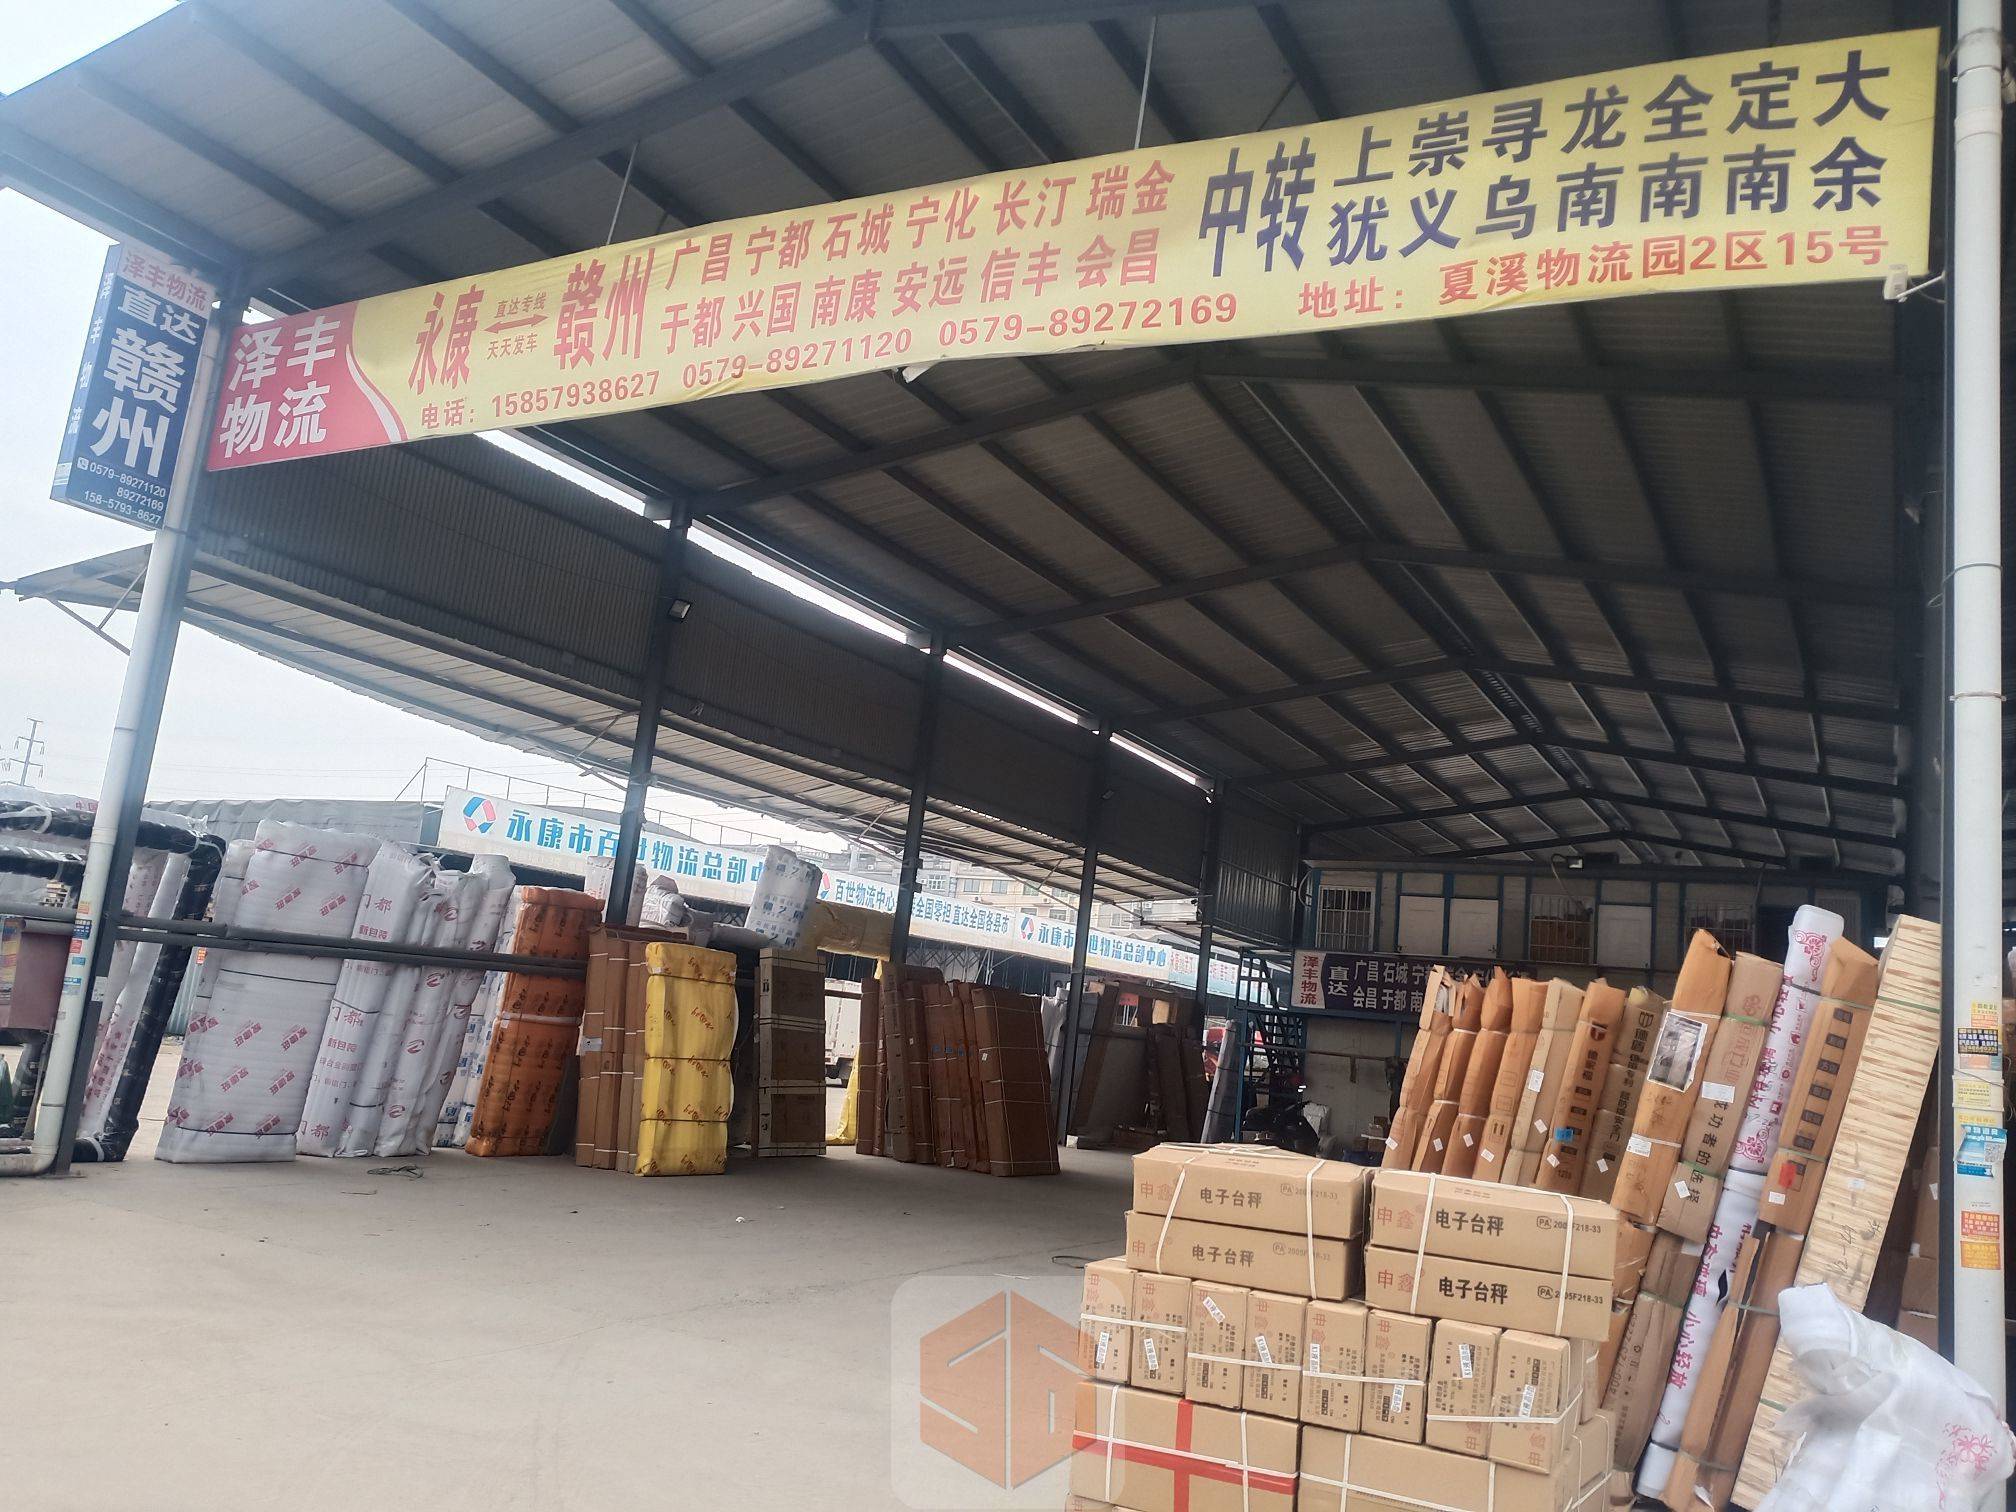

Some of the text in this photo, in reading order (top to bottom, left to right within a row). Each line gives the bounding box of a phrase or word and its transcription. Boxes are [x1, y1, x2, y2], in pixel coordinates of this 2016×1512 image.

[664, 159, 1174, 290] 广昌 宁都 石城 宁化 长汀 瑞金
[1199, 135, 1317, 277] 中转
[123, 250, 208, 312] 泽丰物流
[1438, 224, 1890, 306] 夏溪物流园2区15号
[494, 291, 547, 319] 直达专线
[660, 228, 1160, 355] 于都 兴国 南康 安远 信丰 会昌
[118, 284, 200, 346] 直达
[407, 246, 656, 395] 永康 赣州
[228, 316, 341, 391] 泽丰
[487, 333, 537, 360] 天天发车
[490, 369, 660, 418] 15857938627
[682, 327, 912, 389] 0579-89271120
[939, 292, 1237, 346] 0579-89272169
[90, 327, 186, 478] 赣州
[219, 380, 330, 458] 物流
[89, 461, 166, 498] 0579-89271120
[116, 486, 164, 512] 89272169
[84, 490, 161, 525] 158-5793-8627
[835, 878, 895, 912] 百世物流中心
[1038, 923, 1167, 967] 永康市世物流总部中心
[1301, 955, 1318, 1005] 泽丰物流
[1328, 966, 1349, 997] 直达
[1354, 960, 1378, 982] 广昌
[1383, 962, 1408, 985] 石城
[1353, 990, 1377, 1010] 会昌
[1382, 991, 1407, 1011] 于都
[1200, 1187, 1262, 1209] 电子台秤
[1435, 1209, 1504, 1237] 电子台秤
[1553, 1220, 1601, 1233] 200F218-33
[1192, 1244, 1254, 1266] 电子台秤
[1439, 1276, 1508, 1304] 电子台秤
[1554, 1291, 1603, 1304] 205F218-33
